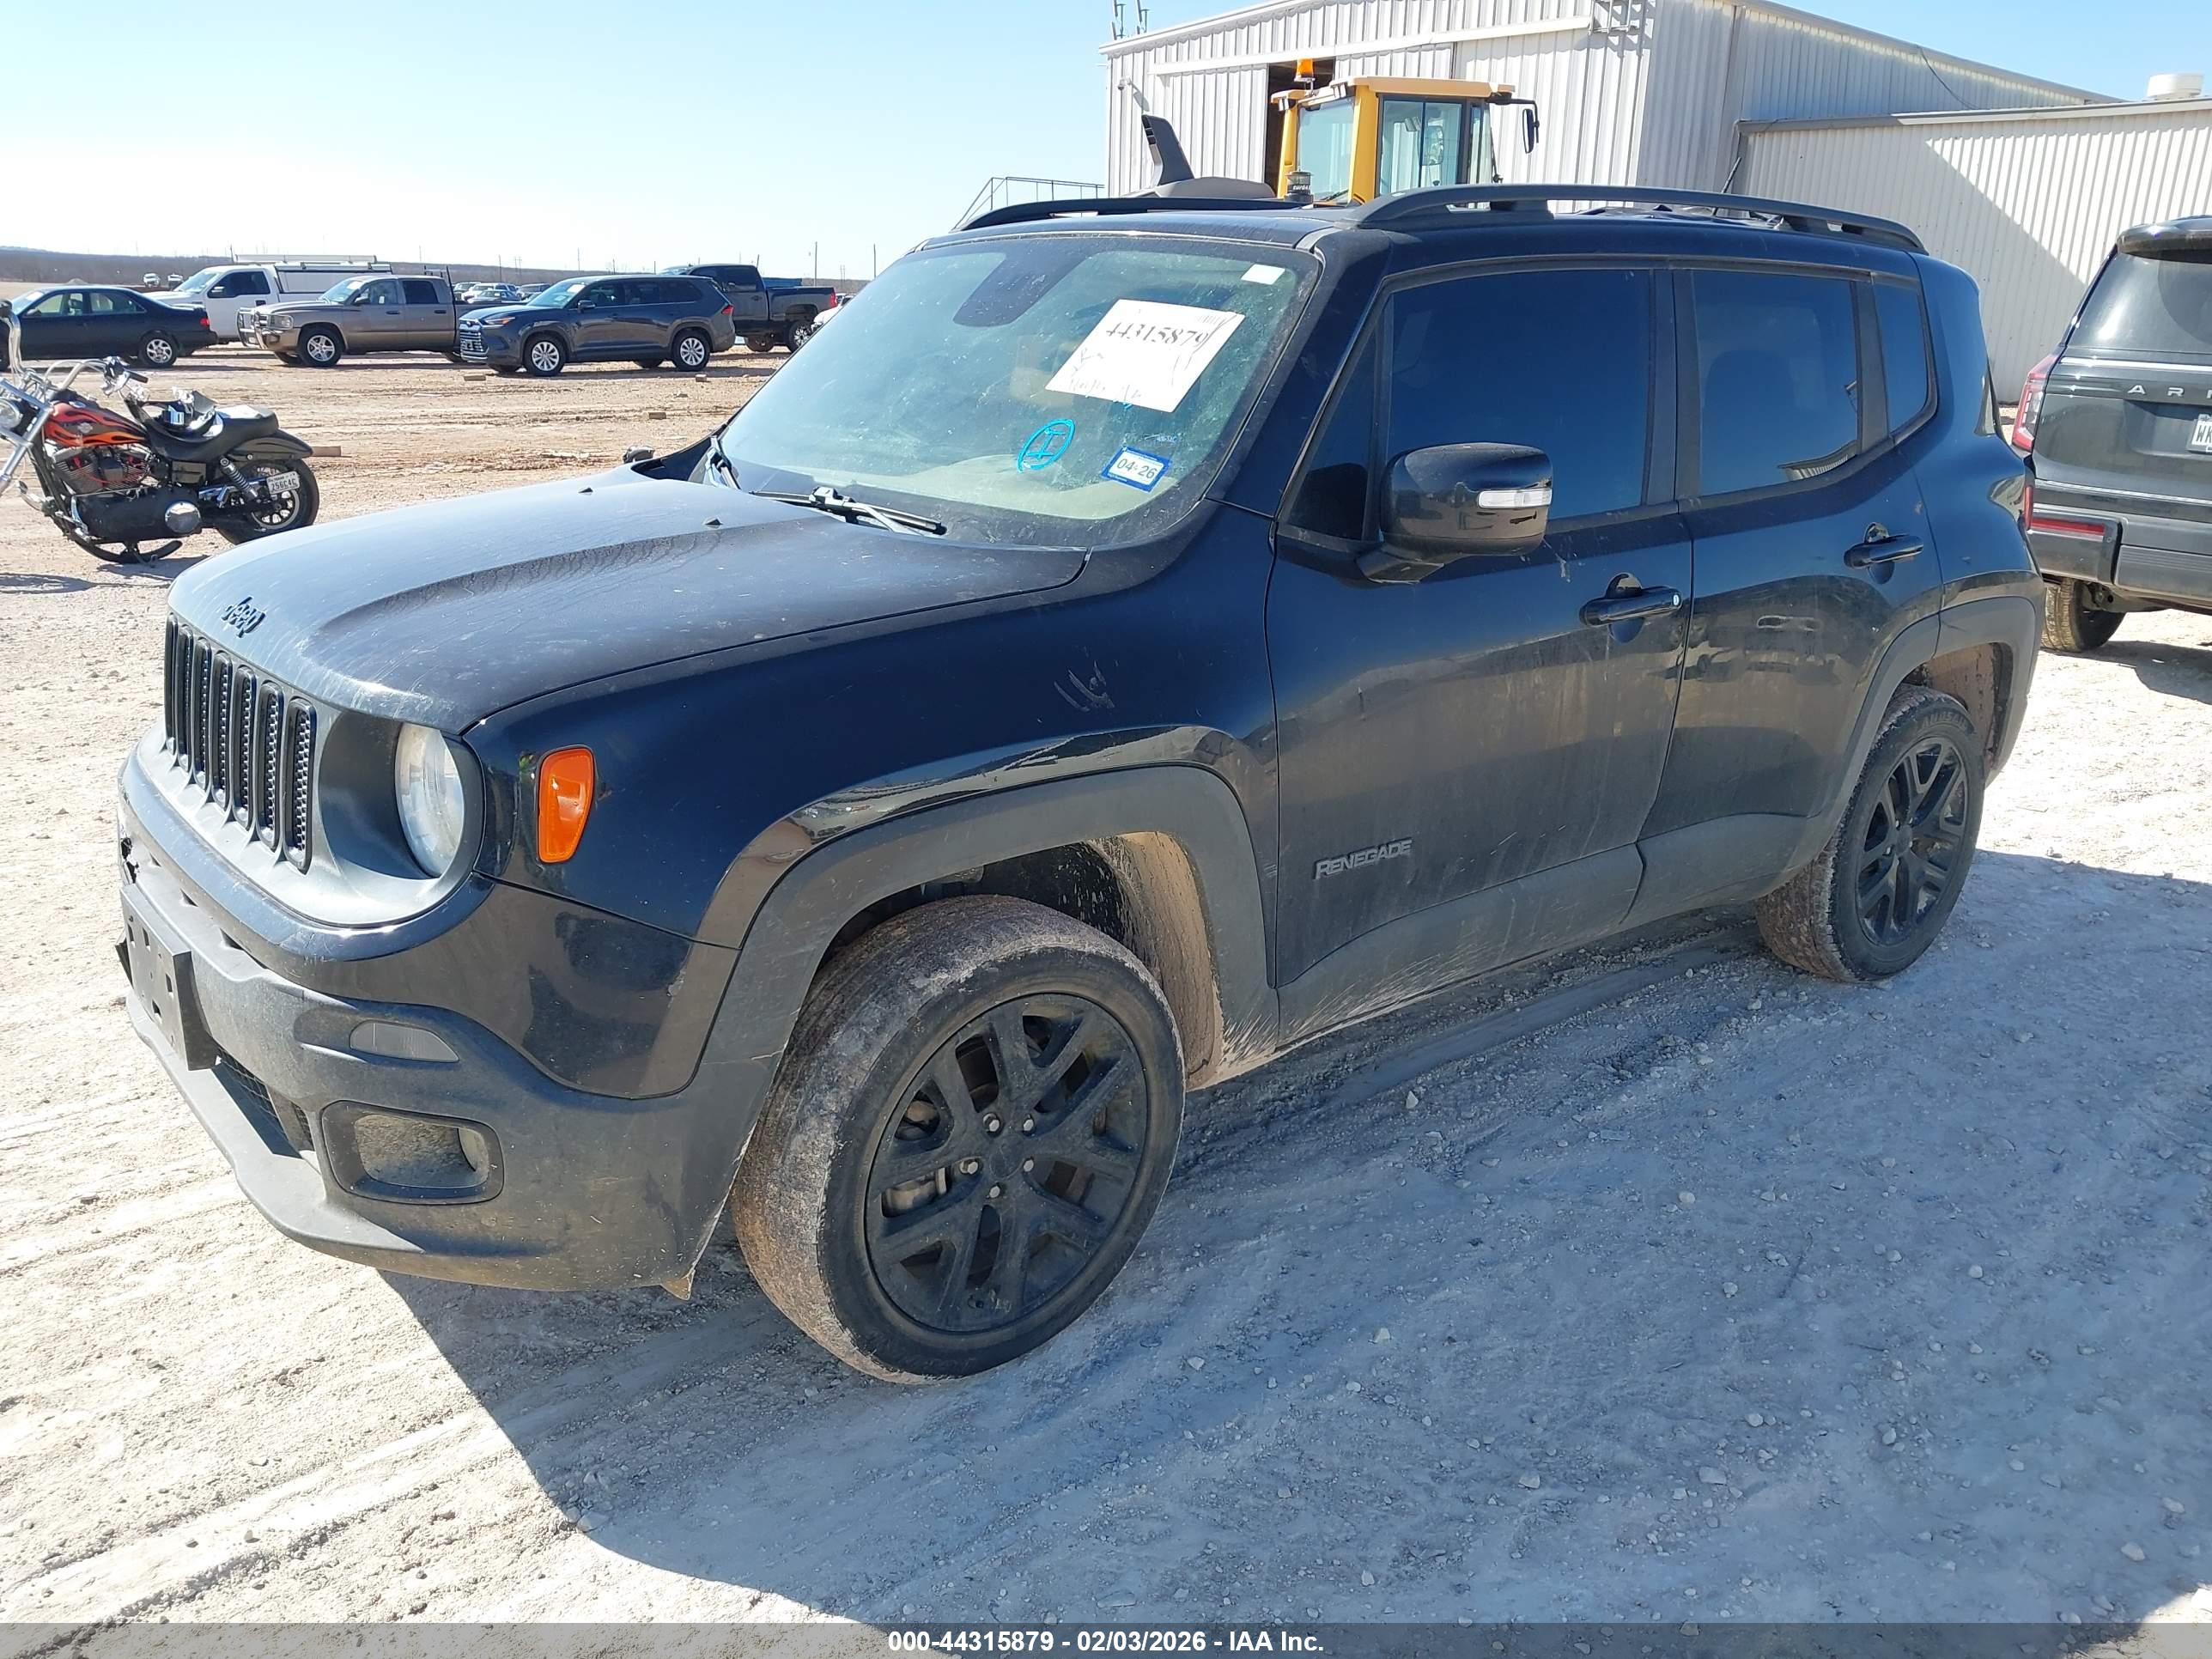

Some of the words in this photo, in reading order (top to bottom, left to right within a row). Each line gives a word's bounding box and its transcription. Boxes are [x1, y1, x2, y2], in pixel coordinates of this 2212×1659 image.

[1105, 321, 1209, 348] 44315879
[221, 596, 266, 638] Jeep
[1313, 836, 1413, 880] RENEGADE
